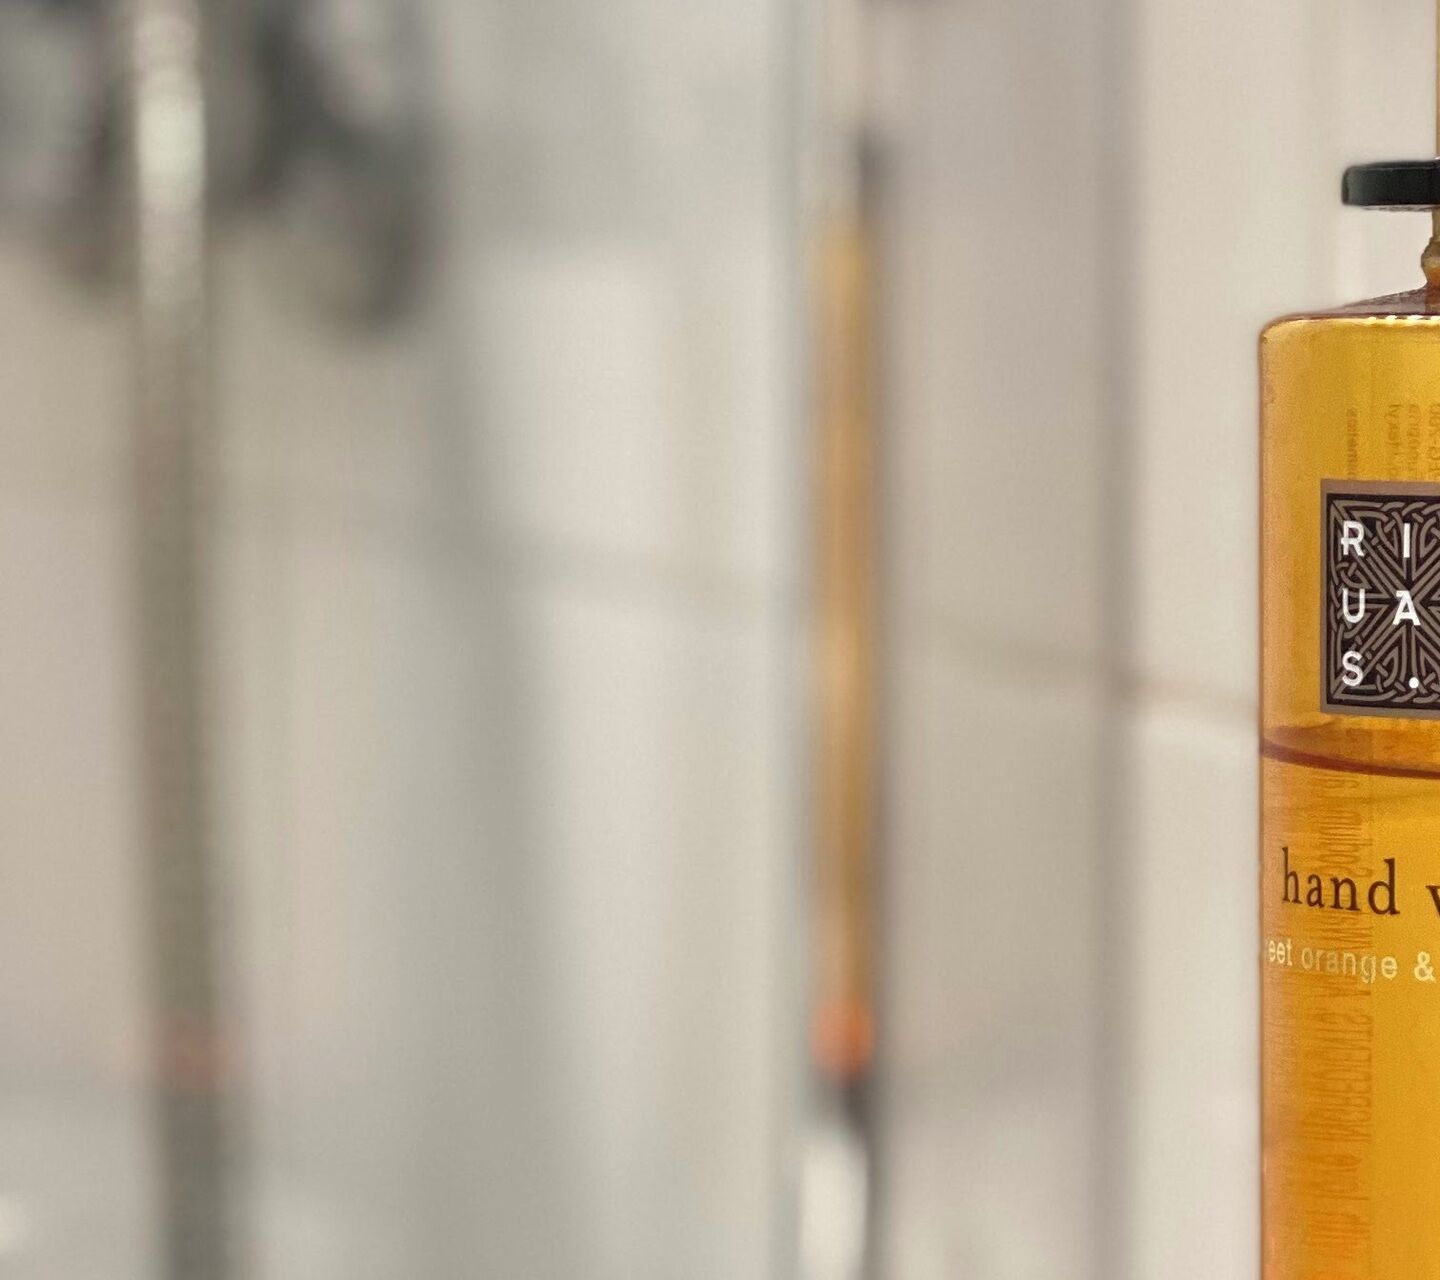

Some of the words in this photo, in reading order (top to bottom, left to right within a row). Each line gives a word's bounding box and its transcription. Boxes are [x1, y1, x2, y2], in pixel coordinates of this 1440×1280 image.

[1280, 846, 1401, 916] hand
[1301, 947, 1398, 984] orange
[1413, 950, 1437, 984] &
